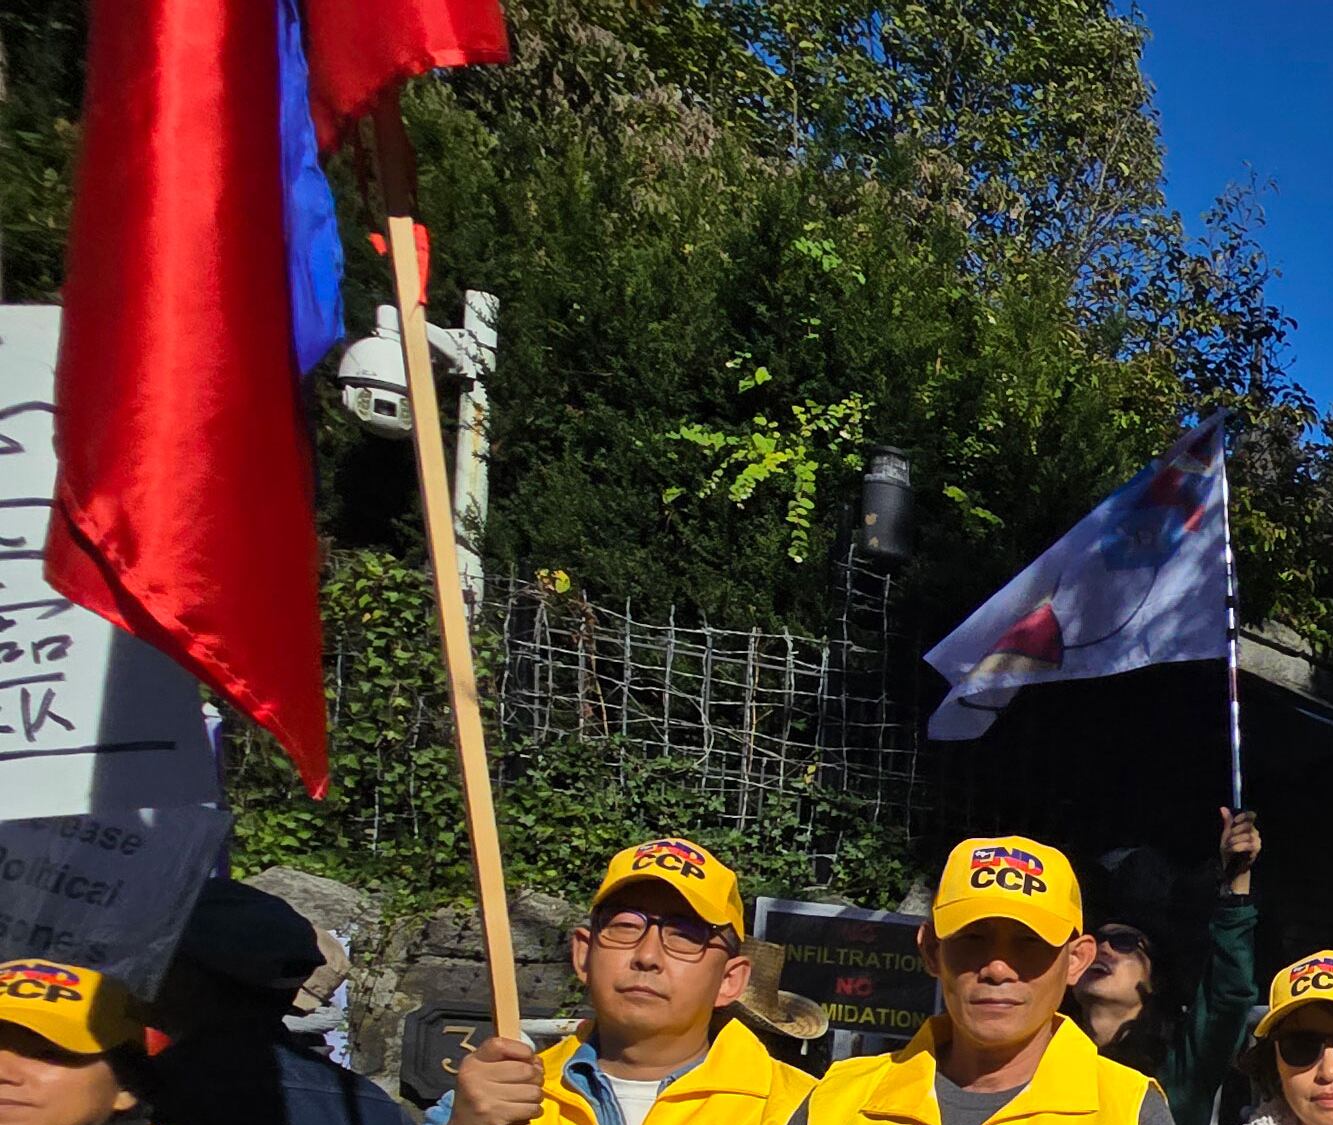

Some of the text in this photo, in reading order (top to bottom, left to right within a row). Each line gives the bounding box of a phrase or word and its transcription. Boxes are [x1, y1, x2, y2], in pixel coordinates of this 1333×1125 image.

[631, 852, 706, 881] CCP
[971, 846, 1044, 877] END
[970, 865, 1048, 897] CCP
[787, 943, 924, 973] NFILTRATIO
[0, 978, 83, 1004] CP
[834, 976, 875, 998] NO
[820, 1002, 928, 1029] MIDATION
